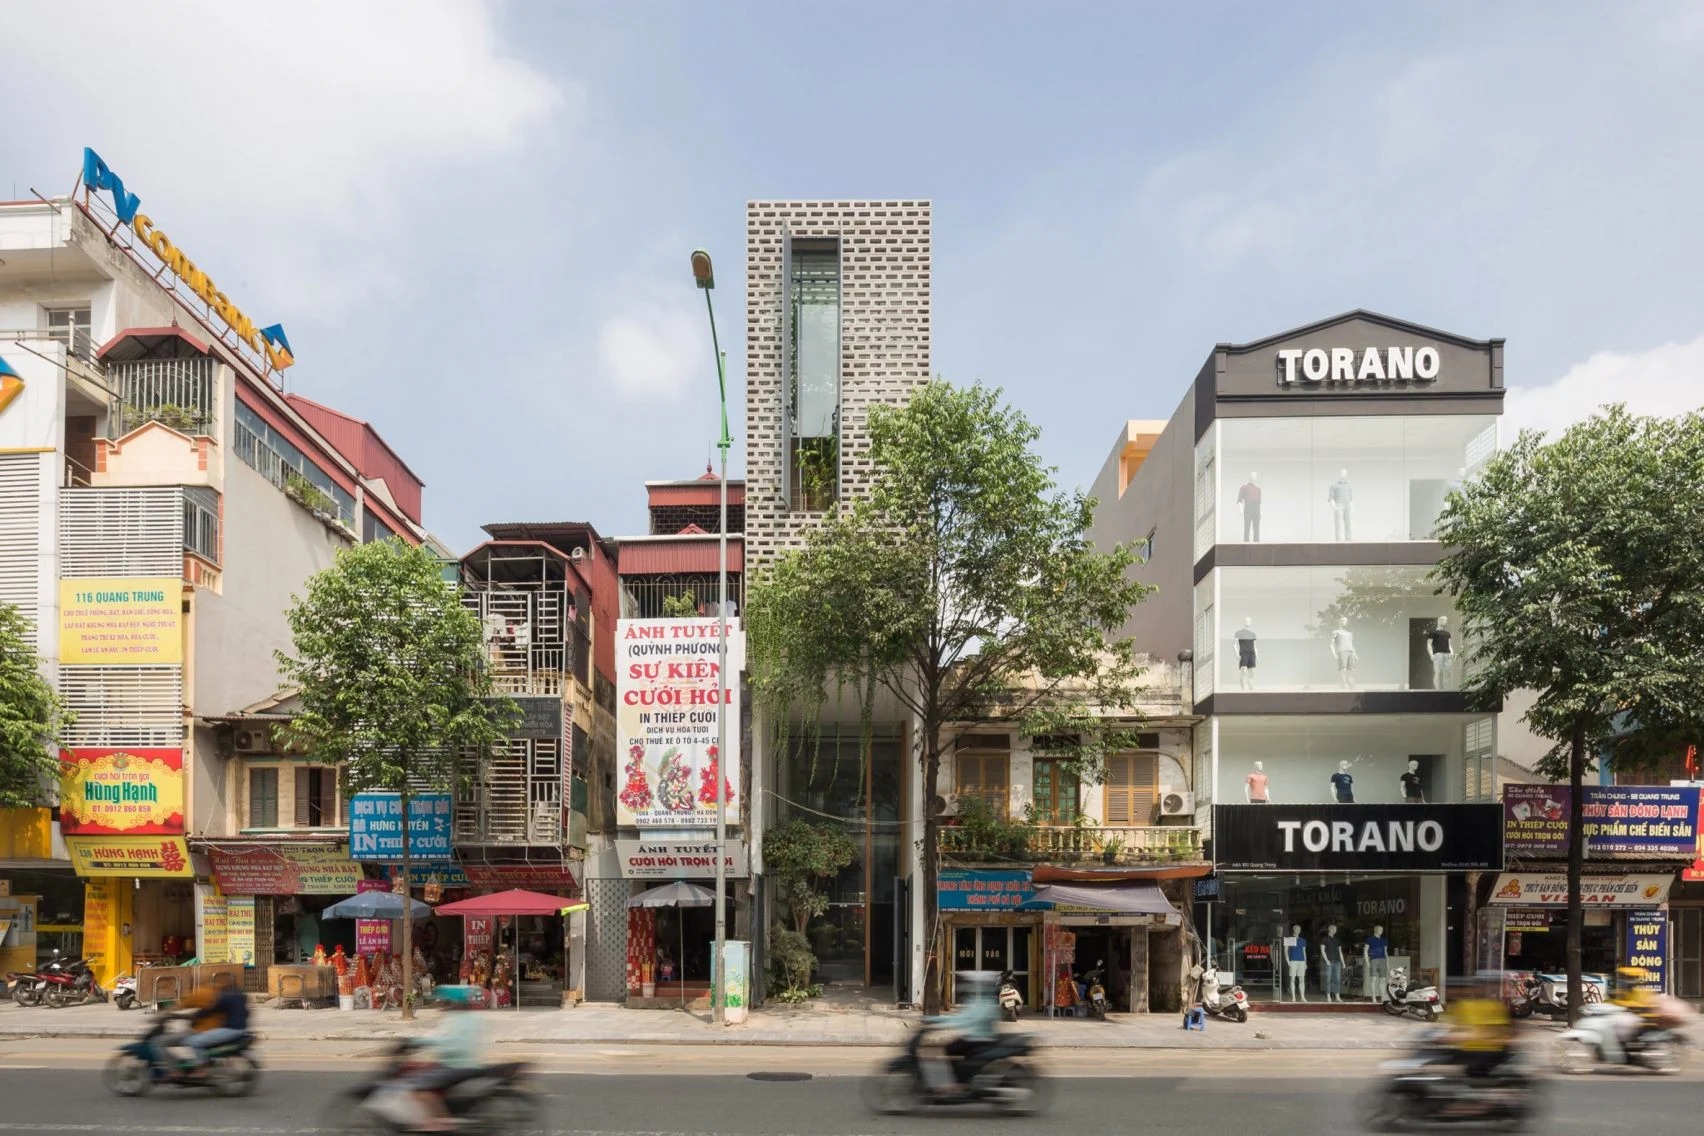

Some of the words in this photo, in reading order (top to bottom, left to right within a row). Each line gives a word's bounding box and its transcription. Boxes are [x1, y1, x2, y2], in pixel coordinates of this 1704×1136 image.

[1278, 346, 1440, 382] TORANO
[76, 592, 93, 603] 116
[96, 591, 129, 603] QUANG
[132, 591, 164, 602] TRUNG
[628, 641, 672, 657] (QUỲNH
[629, 660, 662, 683] SỰ
[623, 685, 682, 706] CƯỚI
[689, 682, 732, 705] HỎI
[639, 712, 651, 723] IN
[654, 709, 686, 723] THIẾP
[690, 709, 716, 723] CƯỚI
[676, 726, 691, 734] HOA
[85, 781, 120, 804] Hùng
[122, 781, 158, 803] Hạnh
[1607, 801, 1628, 817] SẢN
[1629, 802, 1660, 818] ĐÔNG
[1660, 804, 1689, 821] LẠNH
[1506, 820, 1517, 828] IN
[1520, 819, 1545, 829] THIẾP
[1629, 821, 1648, 836] CHẾ
[1649, 821, 1671, 837] BIẾN
[353, 833, 378, 851] IN
[1277, 819, 1444, 853] TORANO
[93, 846, 126, 859] HÙNG
[127, 848, 159, 860] HẠNH
[679, 857, 709, 868] TRỌN
[1356, 898, 1405, 914] TORANO
[471, 920, 486, 930] IN
[1633, 922, 1660, 935] THỦY
[1636, 938, 1657, 951] SẢN
[1631, 954, 1663, 967] ĐÔNG
